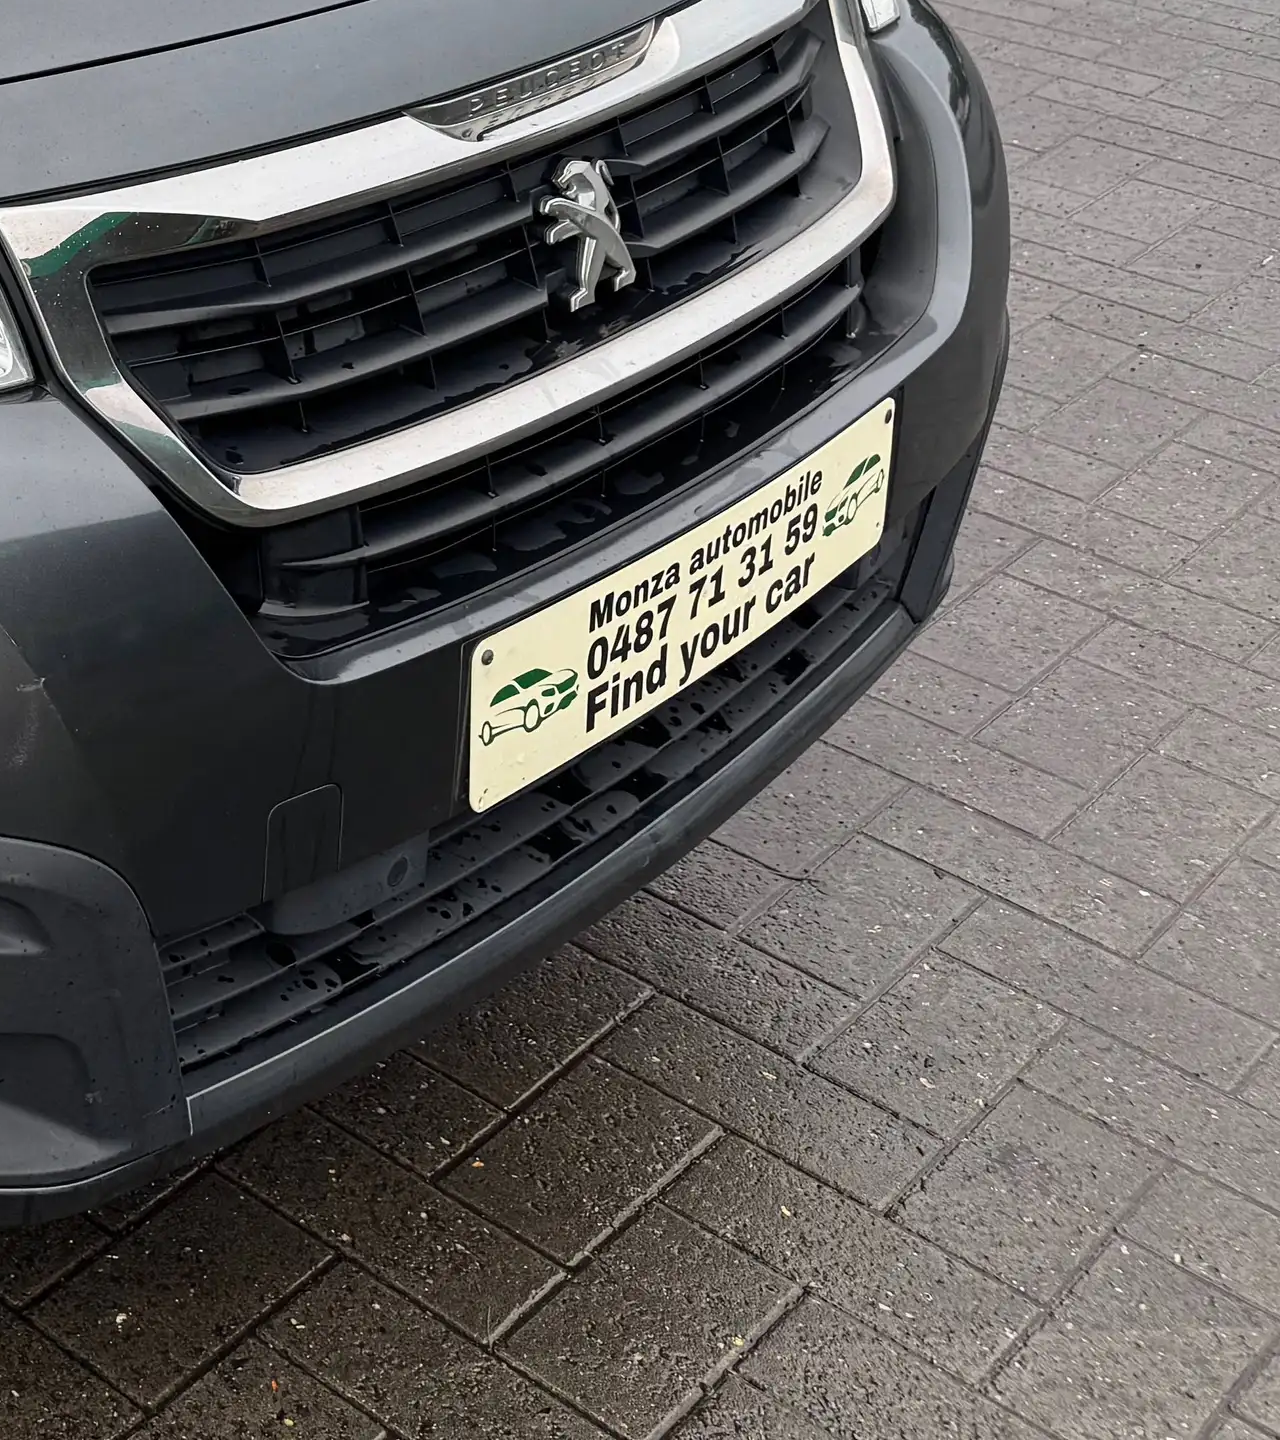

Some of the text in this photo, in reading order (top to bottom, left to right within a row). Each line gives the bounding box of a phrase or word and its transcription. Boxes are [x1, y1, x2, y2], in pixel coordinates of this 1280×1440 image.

[468, 41, 627, 118] PEUGEOT
[587, 503, 819, 680] 0487 71 31 59
[589, 470, 822, 633] Monza automobile
[586, 552, 815, 733] Find your car
